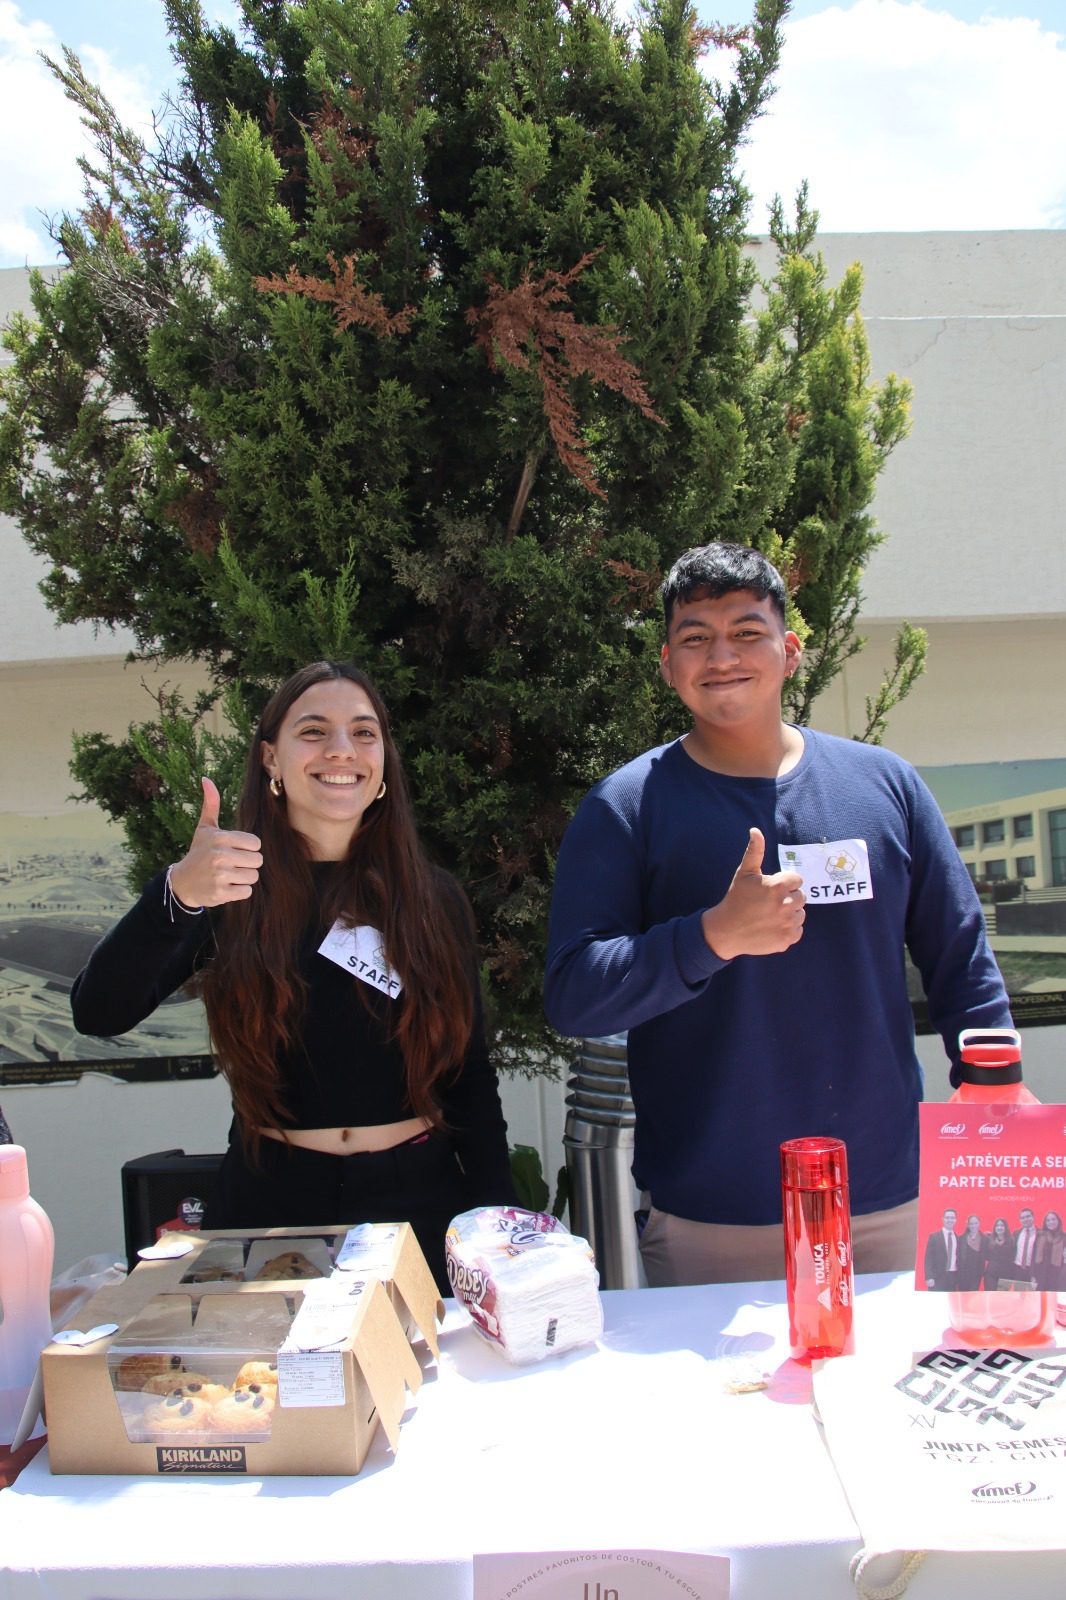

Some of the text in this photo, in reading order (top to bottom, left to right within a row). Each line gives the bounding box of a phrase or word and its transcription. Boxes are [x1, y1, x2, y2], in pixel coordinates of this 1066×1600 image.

[810, 881, 867, 898] STAFF
[347, 955, 400, 990] STAFF
[951, 1152, 1028, 1169] ¡ATRÉVETE
[1031, 1155, 1042, 1168] A
[939, 1176, 1066, 1188] PARTE DEL CAMB
[182, 1202, 205, 1213] EVL
[814, 1242, 825, 1285] TOLUCA
[447, 1253, 489, 1304] Delsey
[907, 1413, 936, 1429] XV
[923, 1436, 1066, 1452] JUNTA SEMES
[161, 1449, 242, 1462] KIRKLAND
[1010, 1448, 1066, 1461] CHI
[162, 1461, 244, 1472] Signature
[506, 1569, 544, 1598] POSTRES
[546, 1554, 598, 1572] FAVORITOS
[616, 1555, 653, 1567] COSTCO
[655, 1565, 662, 1573] A
[664, 1570, 675, 1580] TU
[584, 1583, 619, 1600] Un
